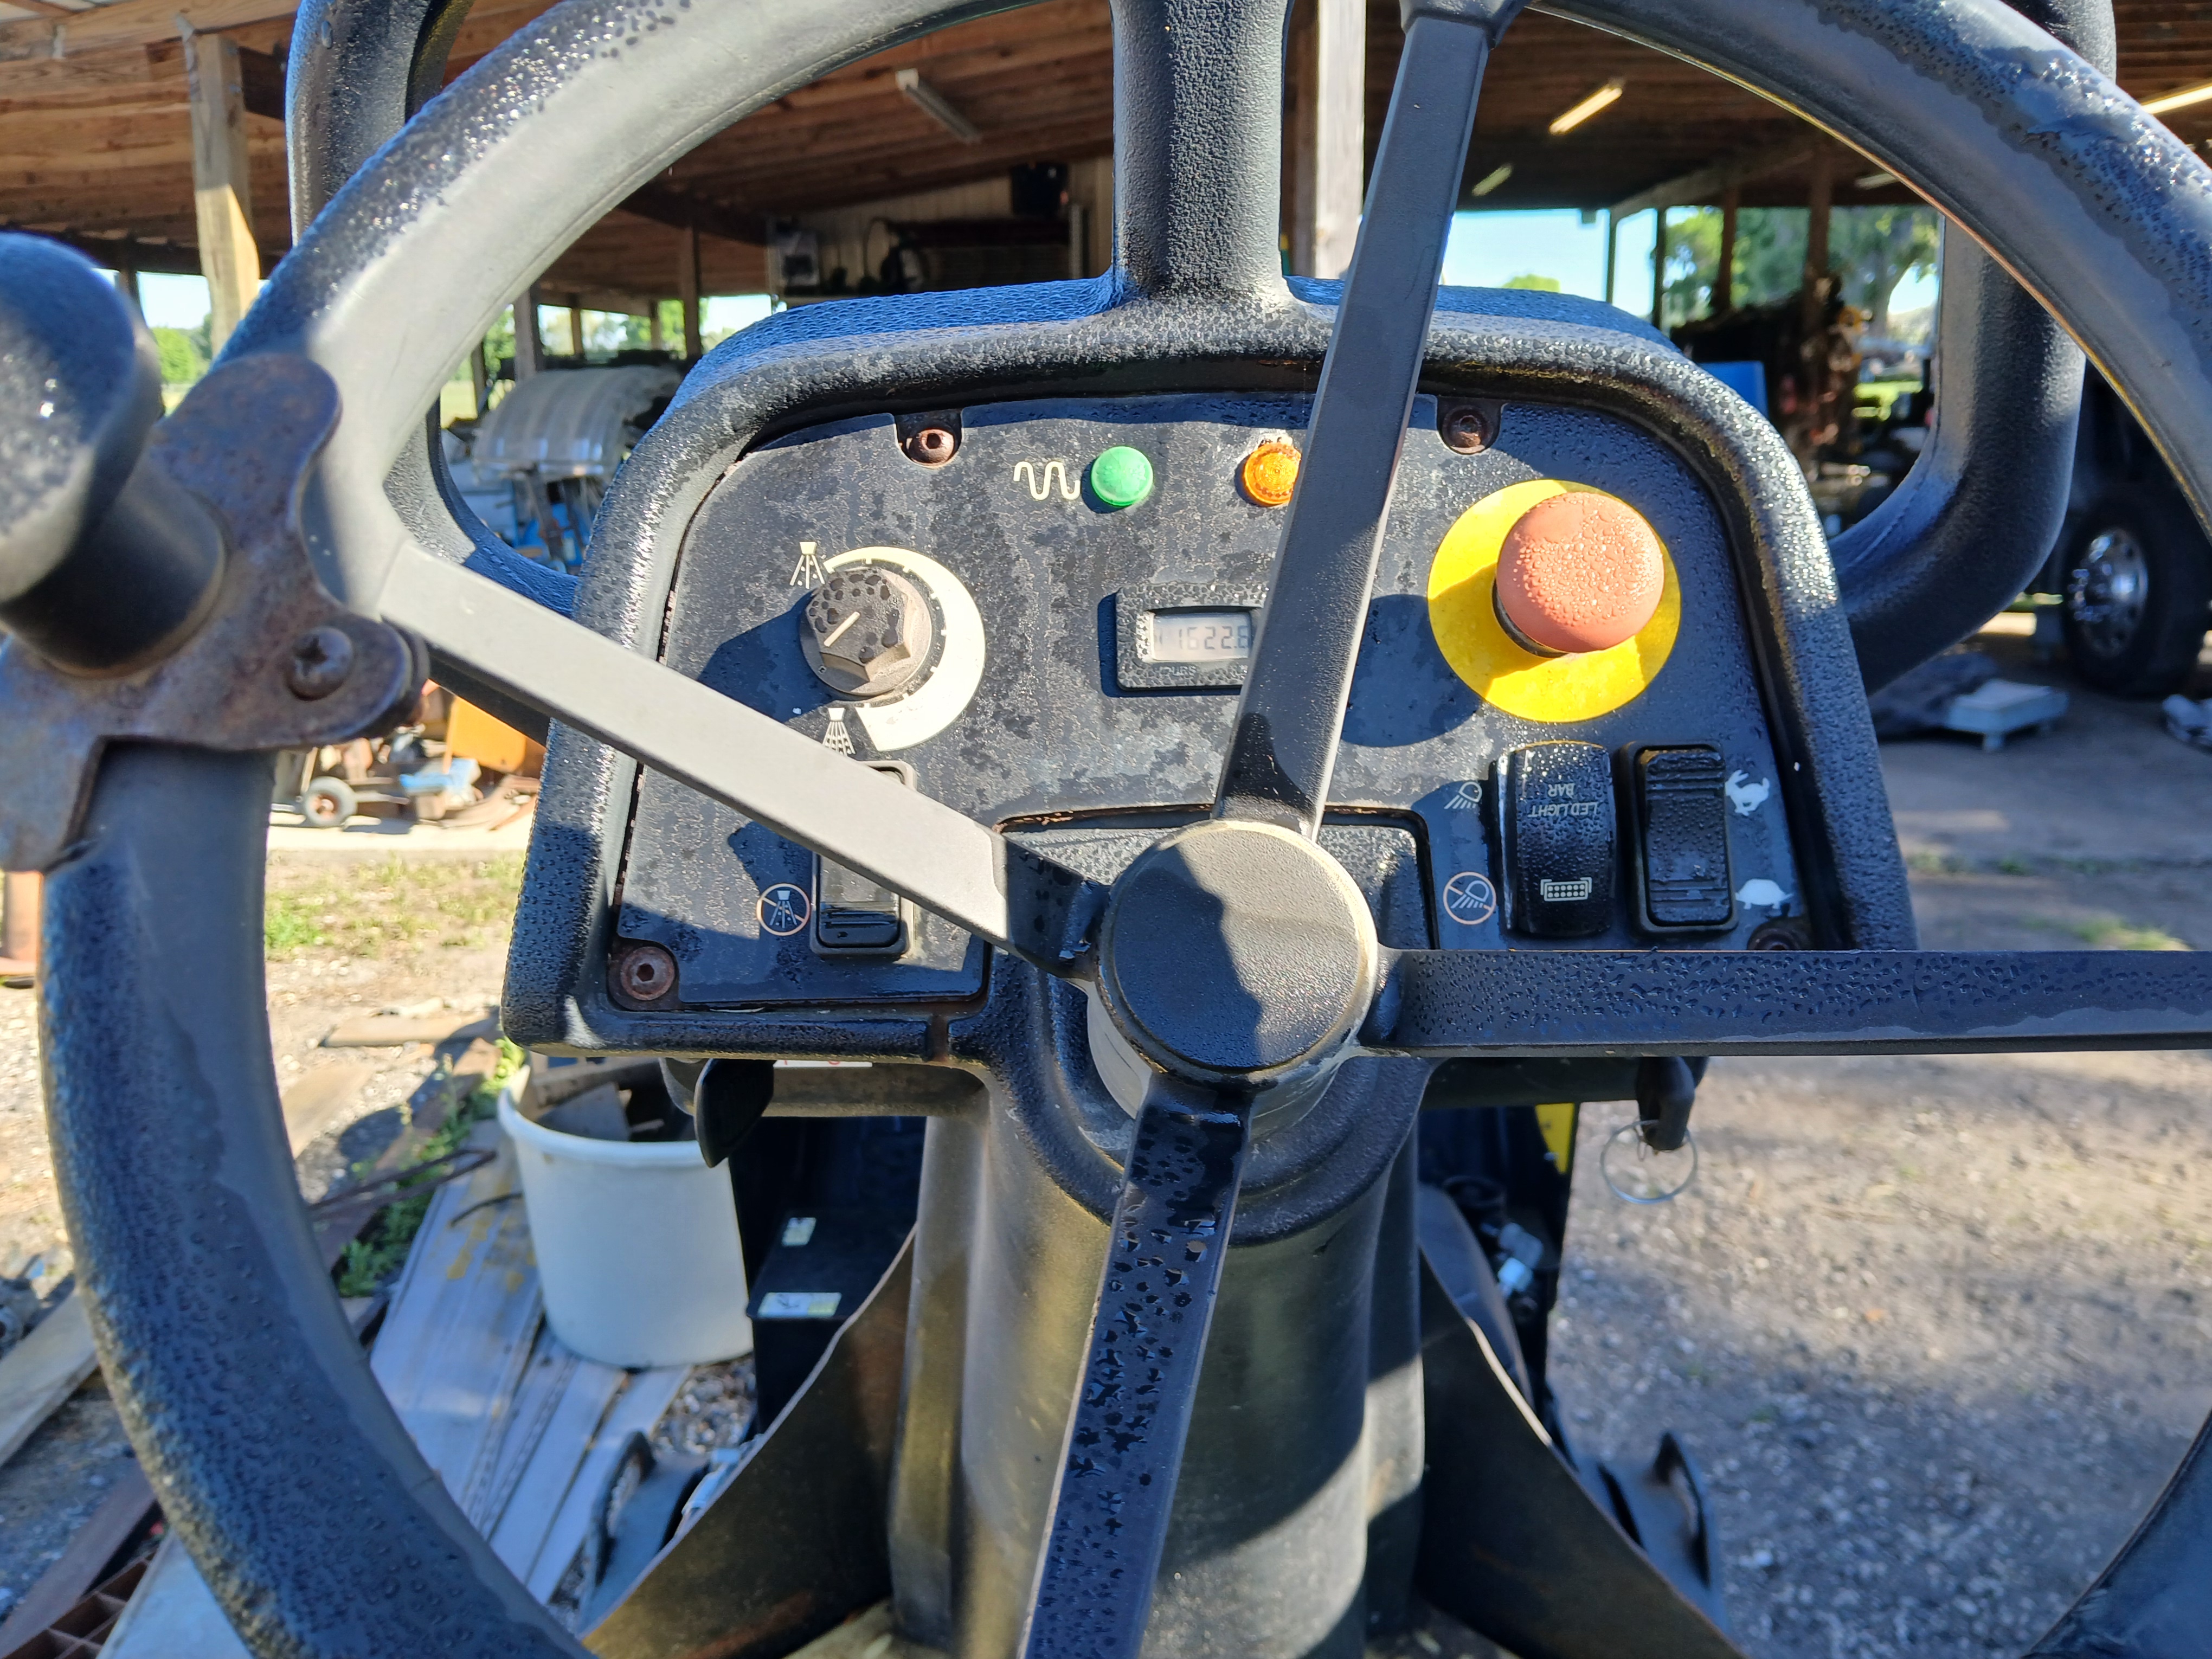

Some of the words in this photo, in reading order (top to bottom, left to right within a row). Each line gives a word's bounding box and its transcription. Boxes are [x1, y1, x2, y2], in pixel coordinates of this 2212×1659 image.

[1548, 783, 1575, 798] BAR
[1527, 803, 1569, 818] LIGHT
[1571, 802, 1599, 815] LED
